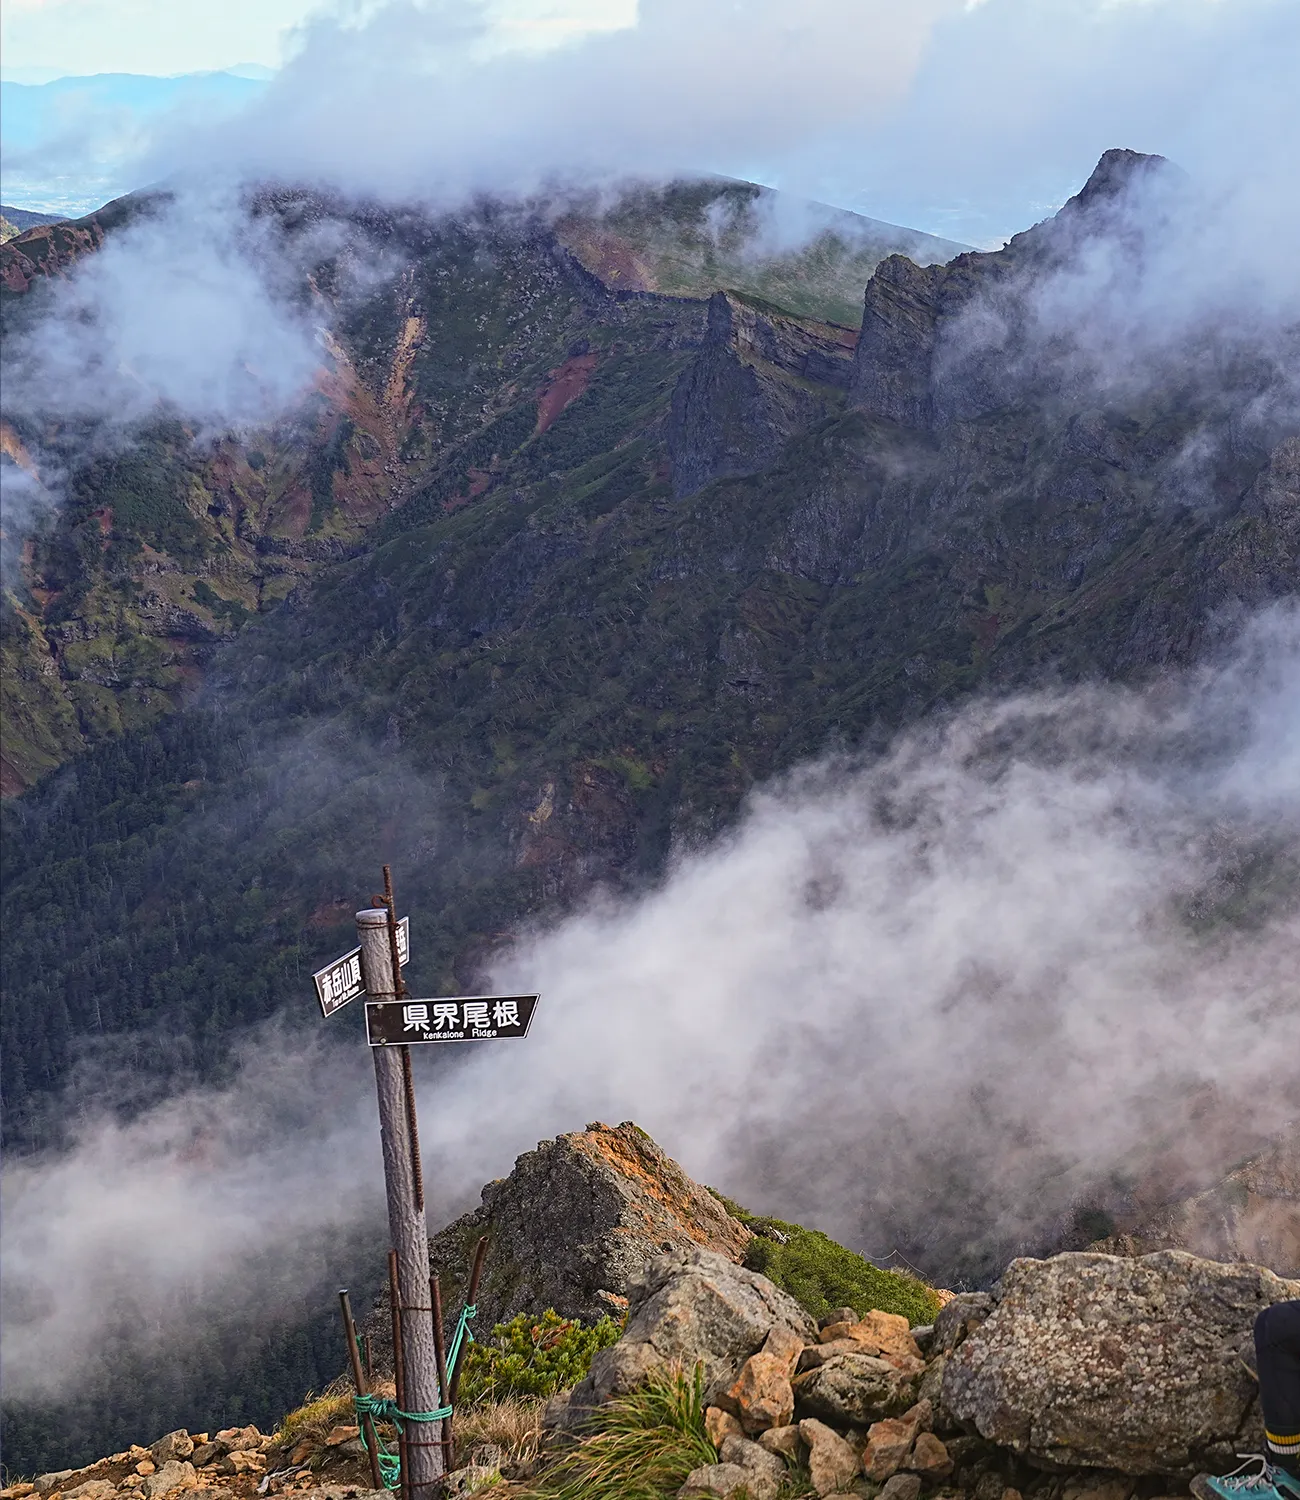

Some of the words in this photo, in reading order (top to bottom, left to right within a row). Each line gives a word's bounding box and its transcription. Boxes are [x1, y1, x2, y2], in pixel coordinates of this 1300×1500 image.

[402, 1000, 520, 1032] 県界尾根
[472, 1028, 497, 1038] Ridge
